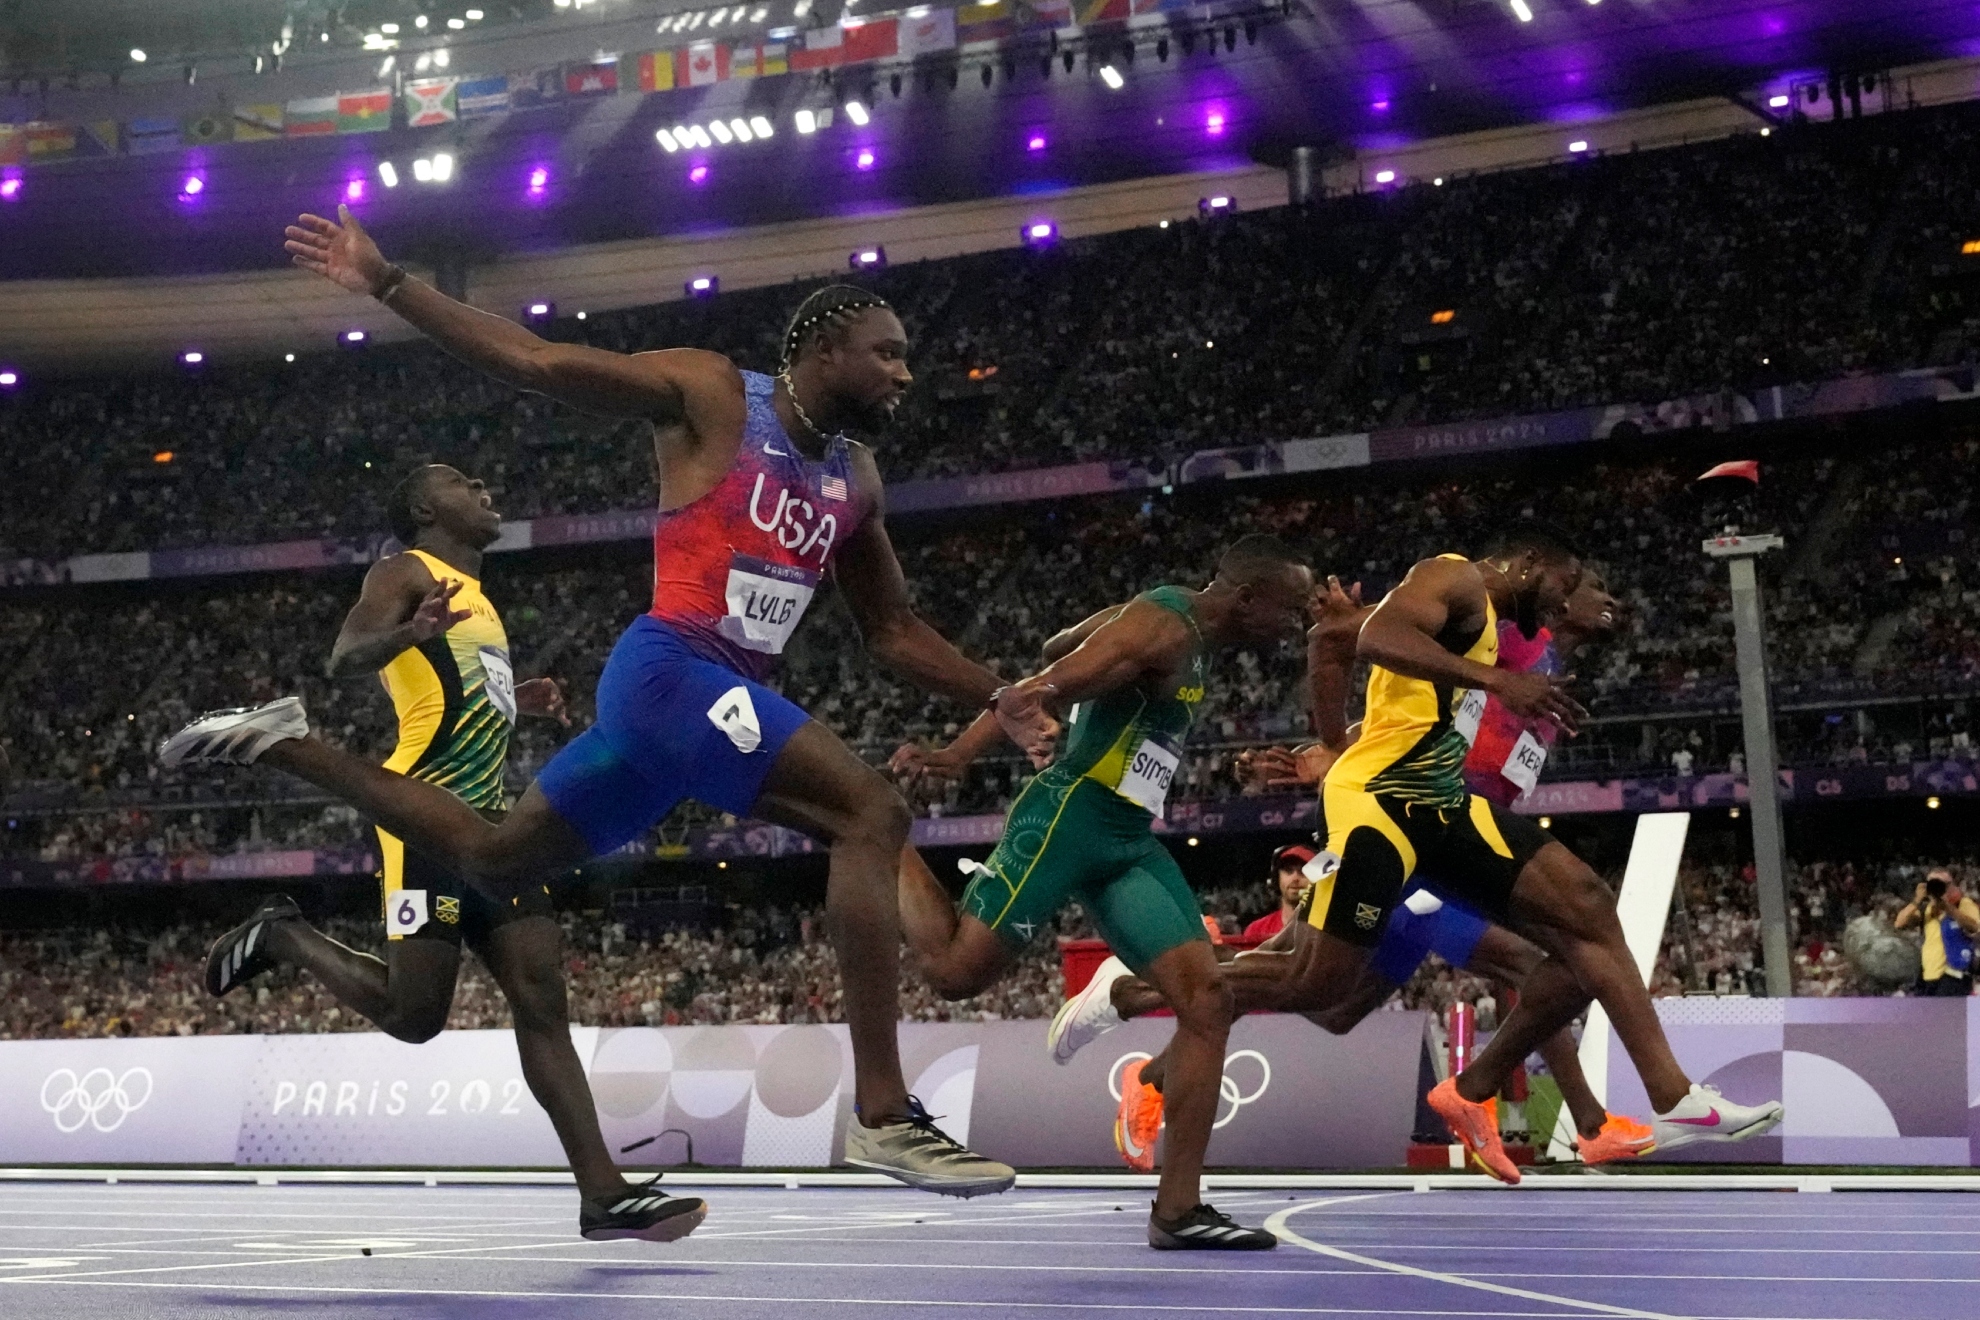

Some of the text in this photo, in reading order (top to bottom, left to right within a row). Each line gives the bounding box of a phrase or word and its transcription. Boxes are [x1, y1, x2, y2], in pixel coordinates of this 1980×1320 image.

[1415, 423, 1546, 450] PARIS 2024
[750, 473, 836, 564] USA
[1132, 753, 1171, 790] SIMB
[397, 899, 416, 926] 6
[272, 1078, 523, 1116] PARIS 202
